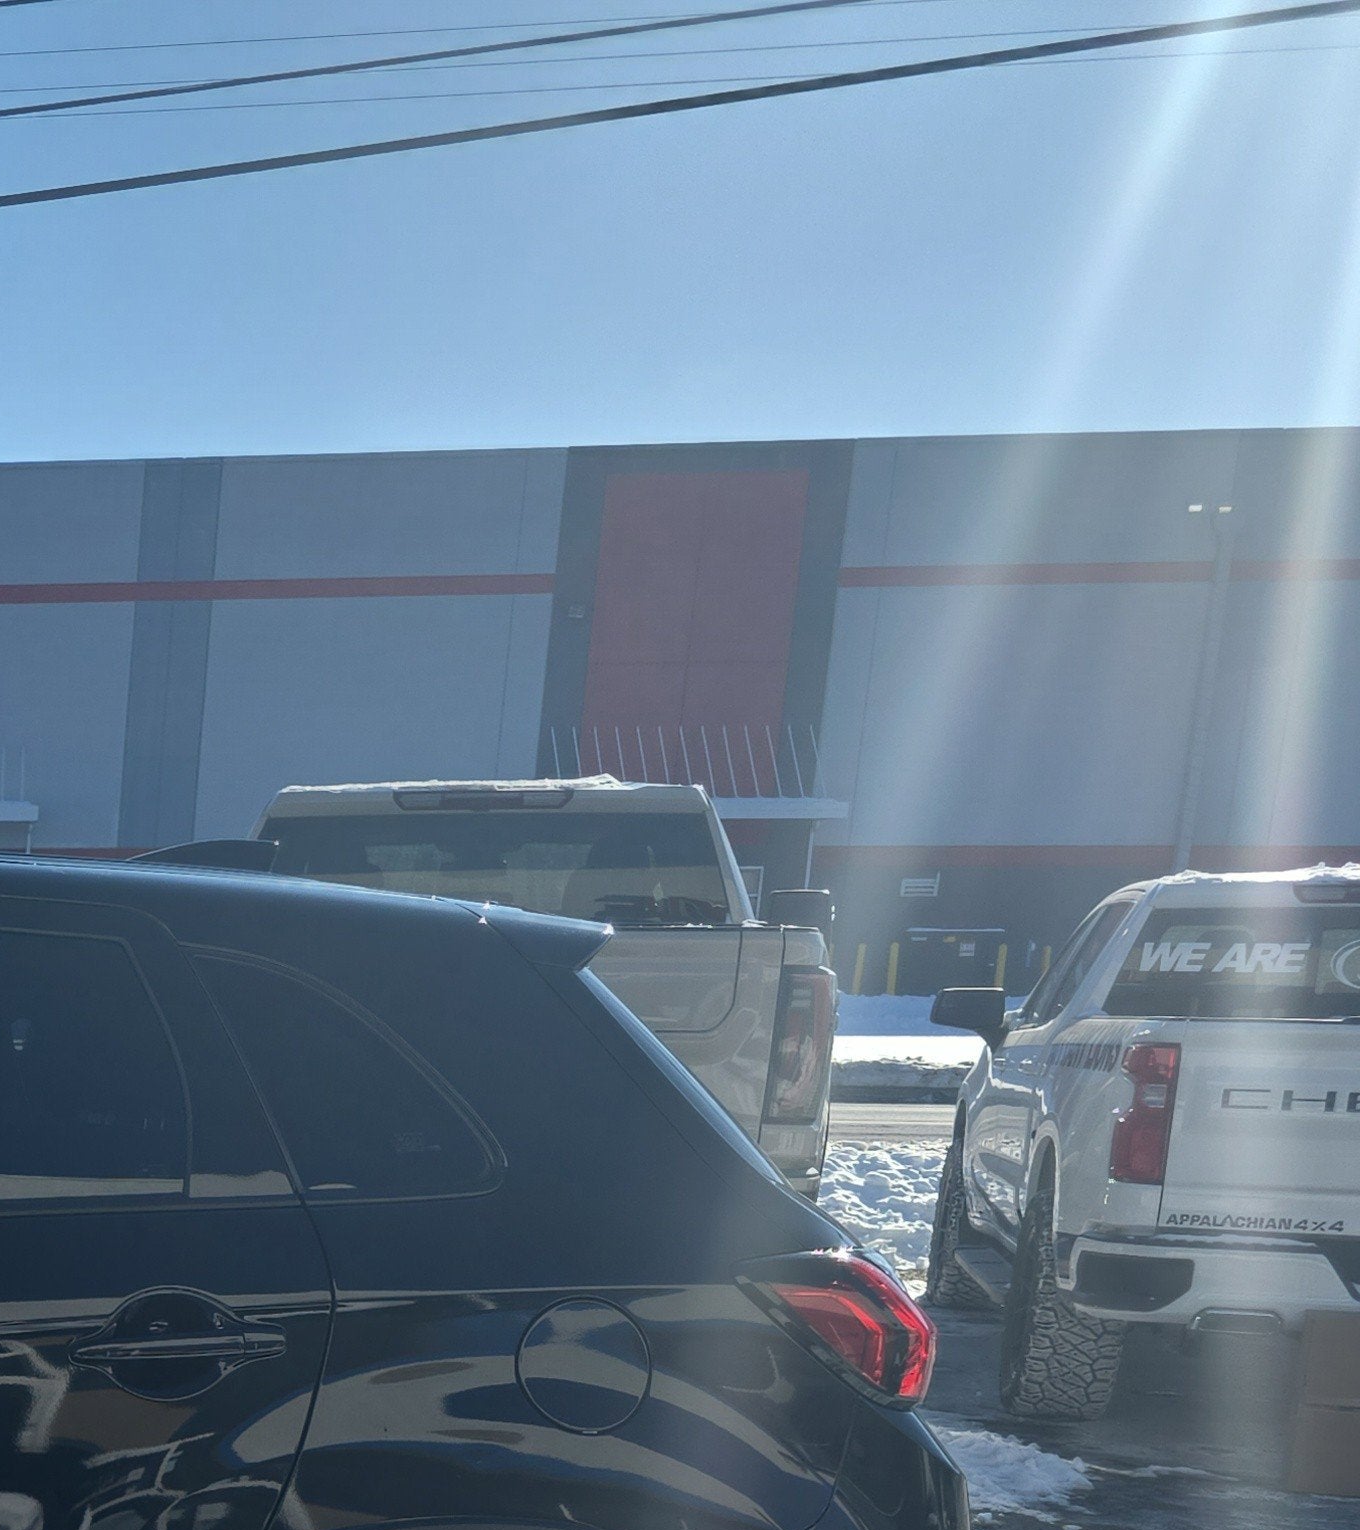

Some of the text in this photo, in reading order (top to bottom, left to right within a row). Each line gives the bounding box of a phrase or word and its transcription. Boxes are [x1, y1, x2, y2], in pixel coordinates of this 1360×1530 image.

[1139, 942, 1311, 973] WE ARE
[1165, 1213, 1292, 1230] APPALACHIAN
